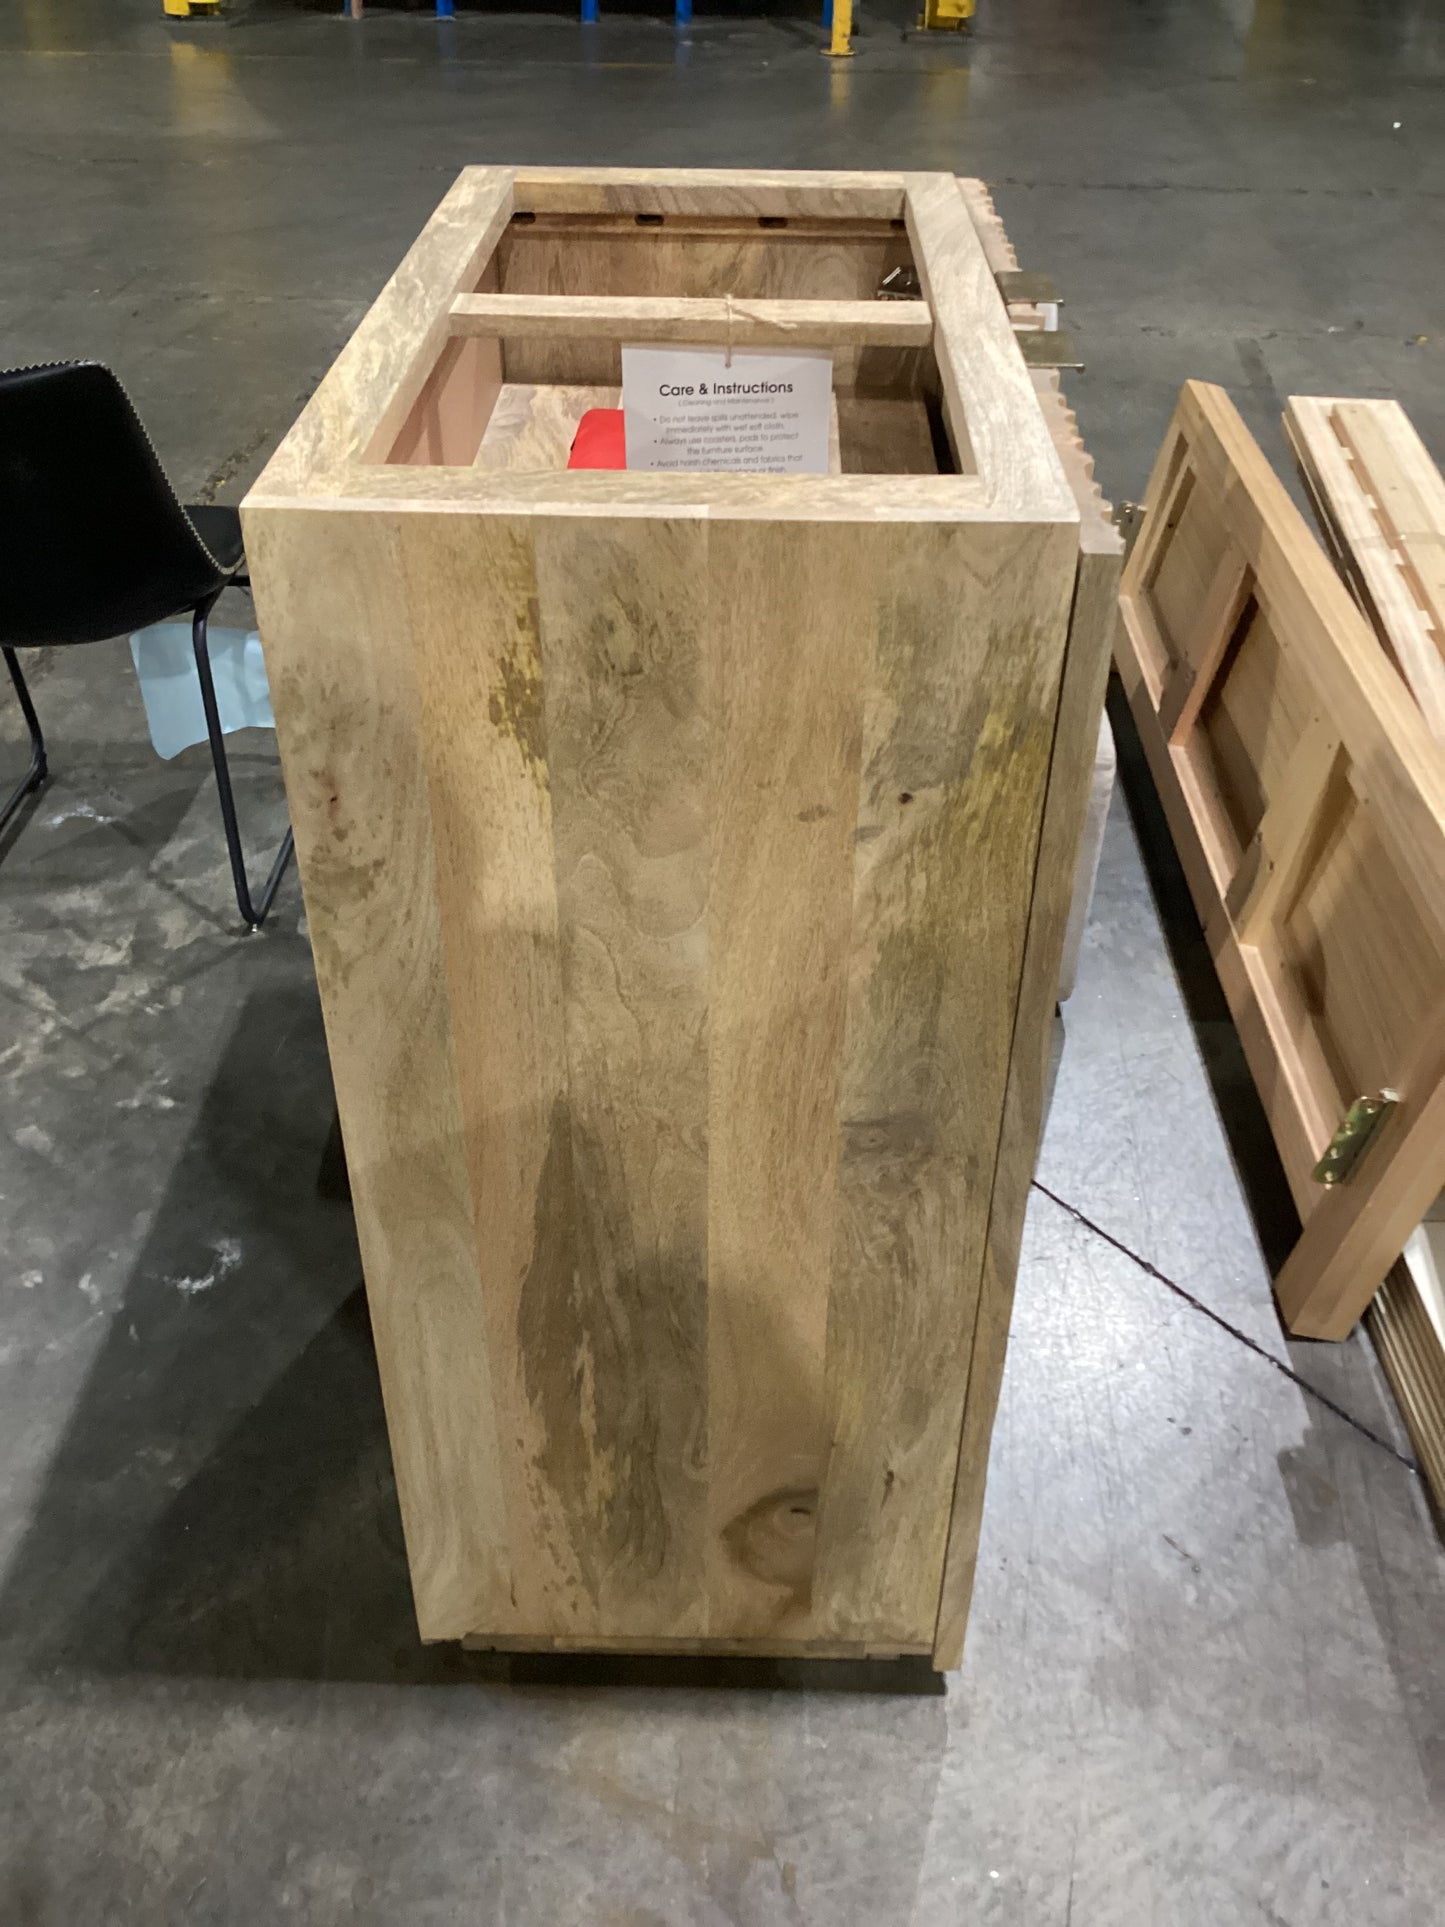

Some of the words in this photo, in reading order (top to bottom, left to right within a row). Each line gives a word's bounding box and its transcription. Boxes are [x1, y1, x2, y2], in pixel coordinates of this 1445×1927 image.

[659, 384, 694, 396] Care
[699, 383, 708, 395] &
[713, 381, 793, 395] Instructions
[716, 424, 732, 432] with
[660, 438, 687, 446] Always
[770, 433, 799, 442] protect
